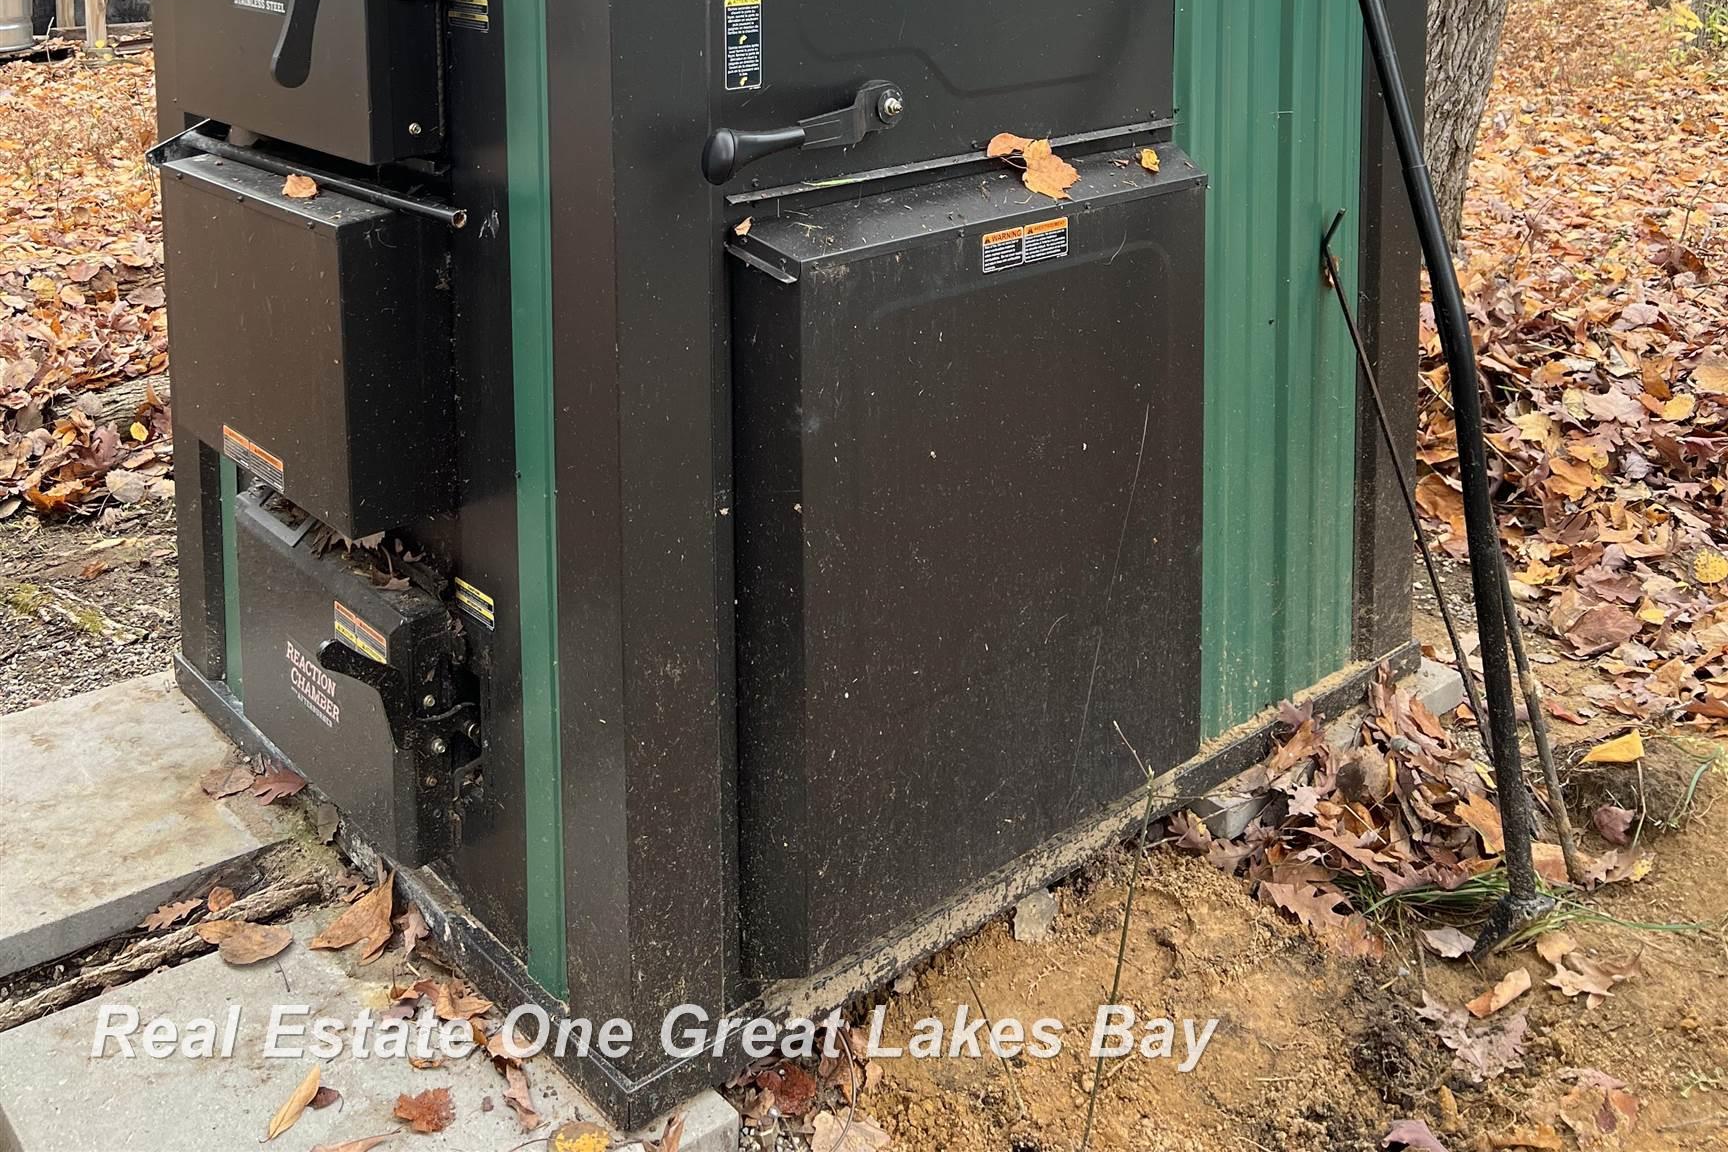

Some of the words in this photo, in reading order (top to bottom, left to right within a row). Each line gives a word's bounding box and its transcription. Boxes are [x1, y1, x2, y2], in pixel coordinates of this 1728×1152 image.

[266, 0, 286, 13] STEEL
[991, 229, 1022, 242] WARNING
[286, 640, 337, 697] REACTION
[291, 667, 340, 723] CHAMBER
